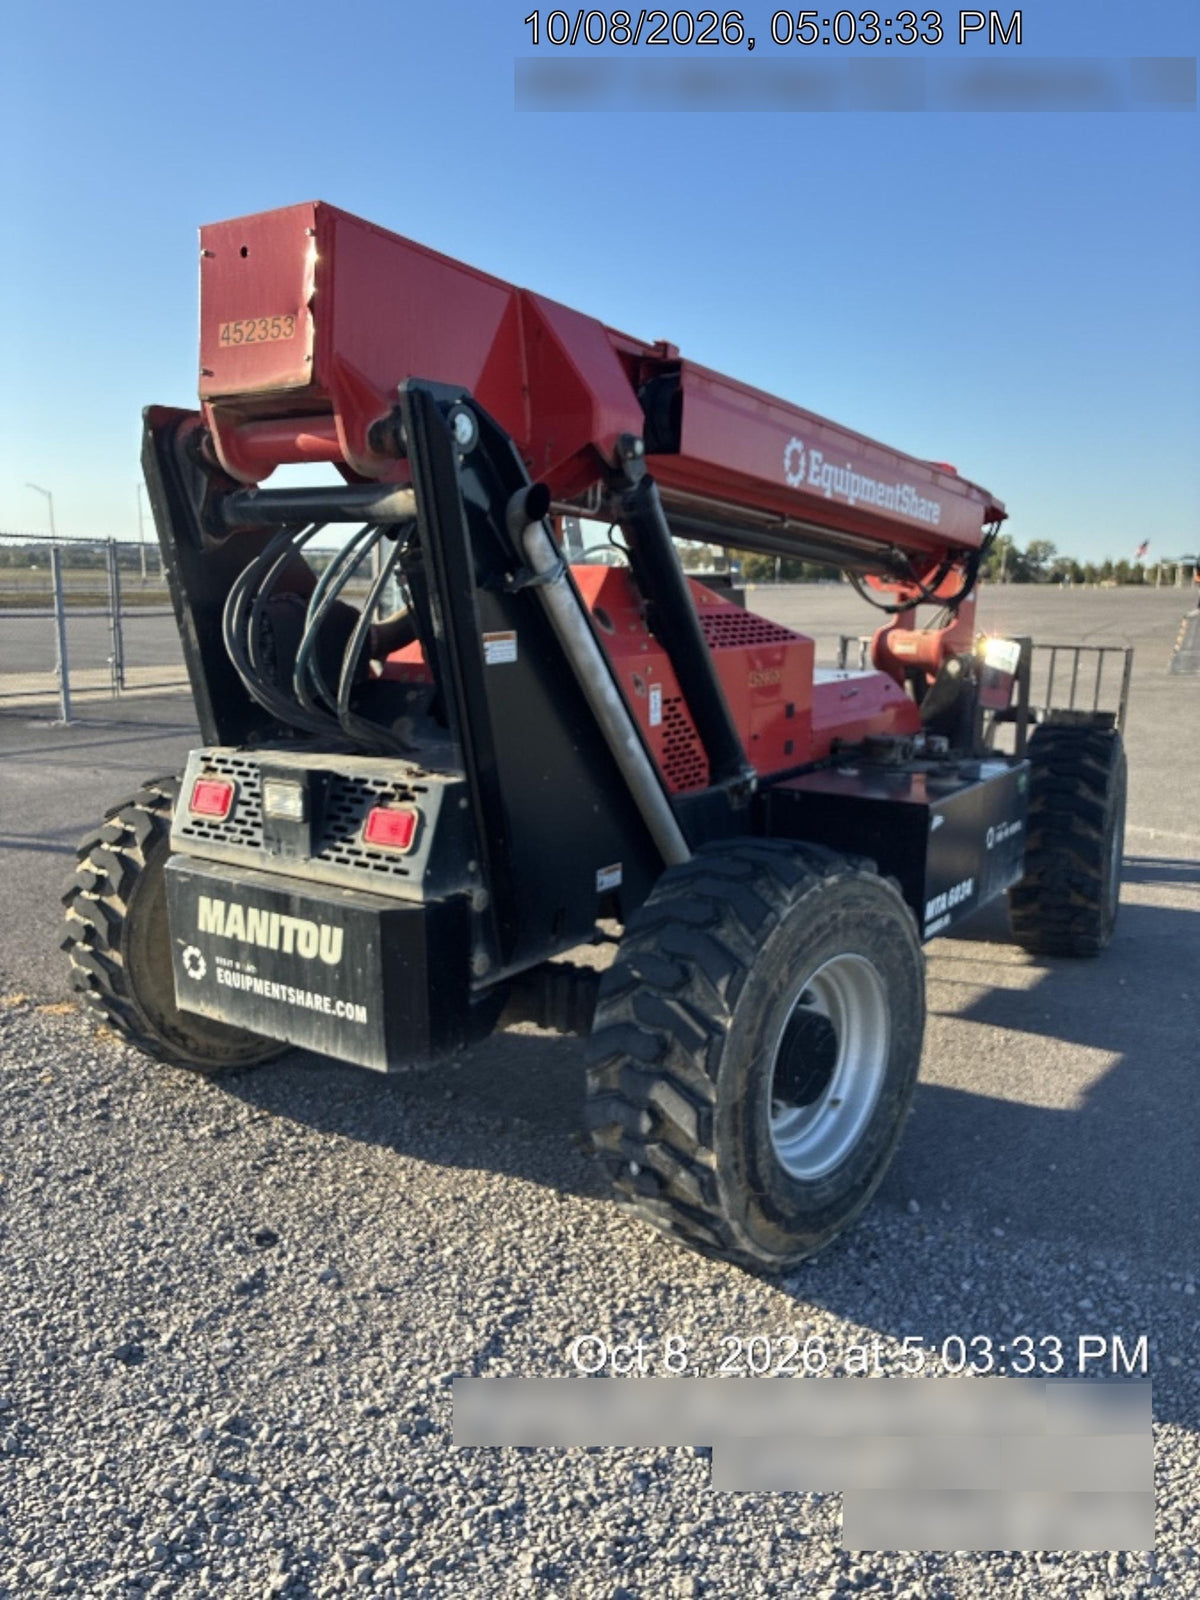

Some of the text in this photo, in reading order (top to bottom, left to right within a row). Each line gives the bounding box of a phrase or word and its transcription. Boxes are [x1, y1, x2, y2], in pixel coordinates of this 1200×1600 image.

[221, 315, 295, 345] 452353
[808, 448, 941, 525] EquipmentShare
[197, 895, 344, 966] MANITOU
[216, 966, 368, 1024] EQUIPMENTSHARE.COM
